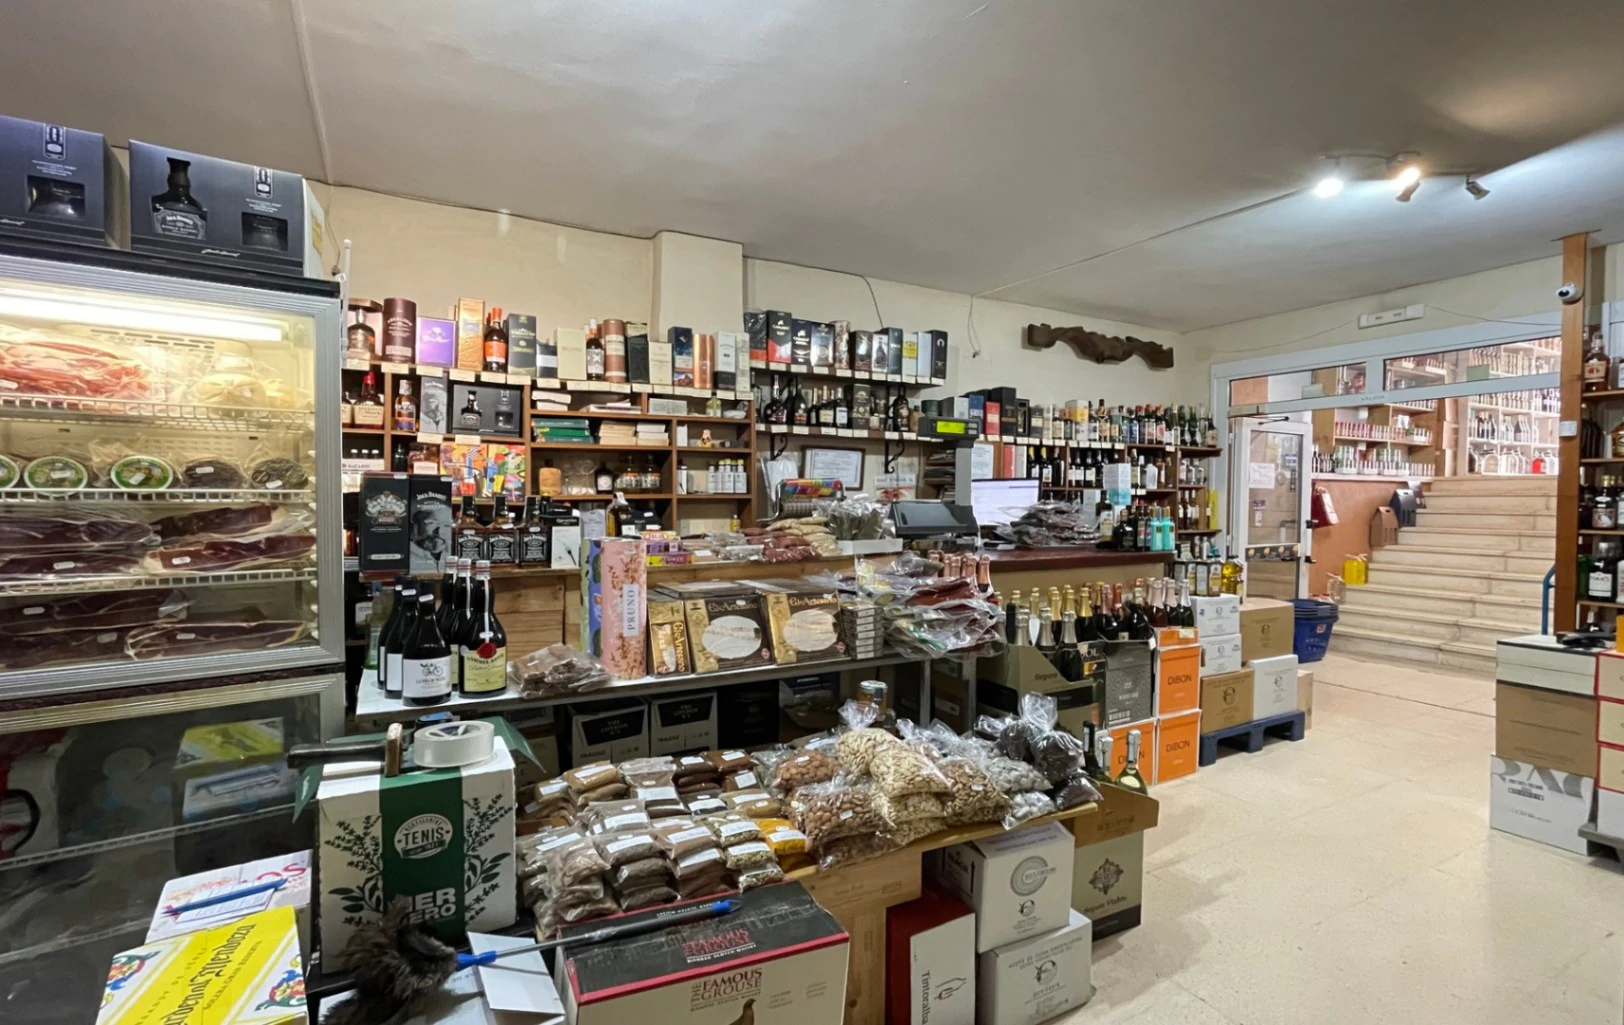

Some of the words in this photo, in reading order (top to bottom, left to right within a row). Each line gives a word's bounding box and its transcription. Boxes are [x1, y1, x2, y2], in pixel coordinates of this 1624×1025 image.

[627, 590, 637, 631] PRUNO
[1167, 674, 1192, 685] DIBON
[1165, 740, 1190, 752] DIBON
[402, 827, 444, 848] TENIS
[701, 977, 762, 1001] GROUSE
[703, 967, 762, 991] FAMOUS
[690, 981, 702, 1002] THE
[921, 970, 931, 1025] Tintoralba
